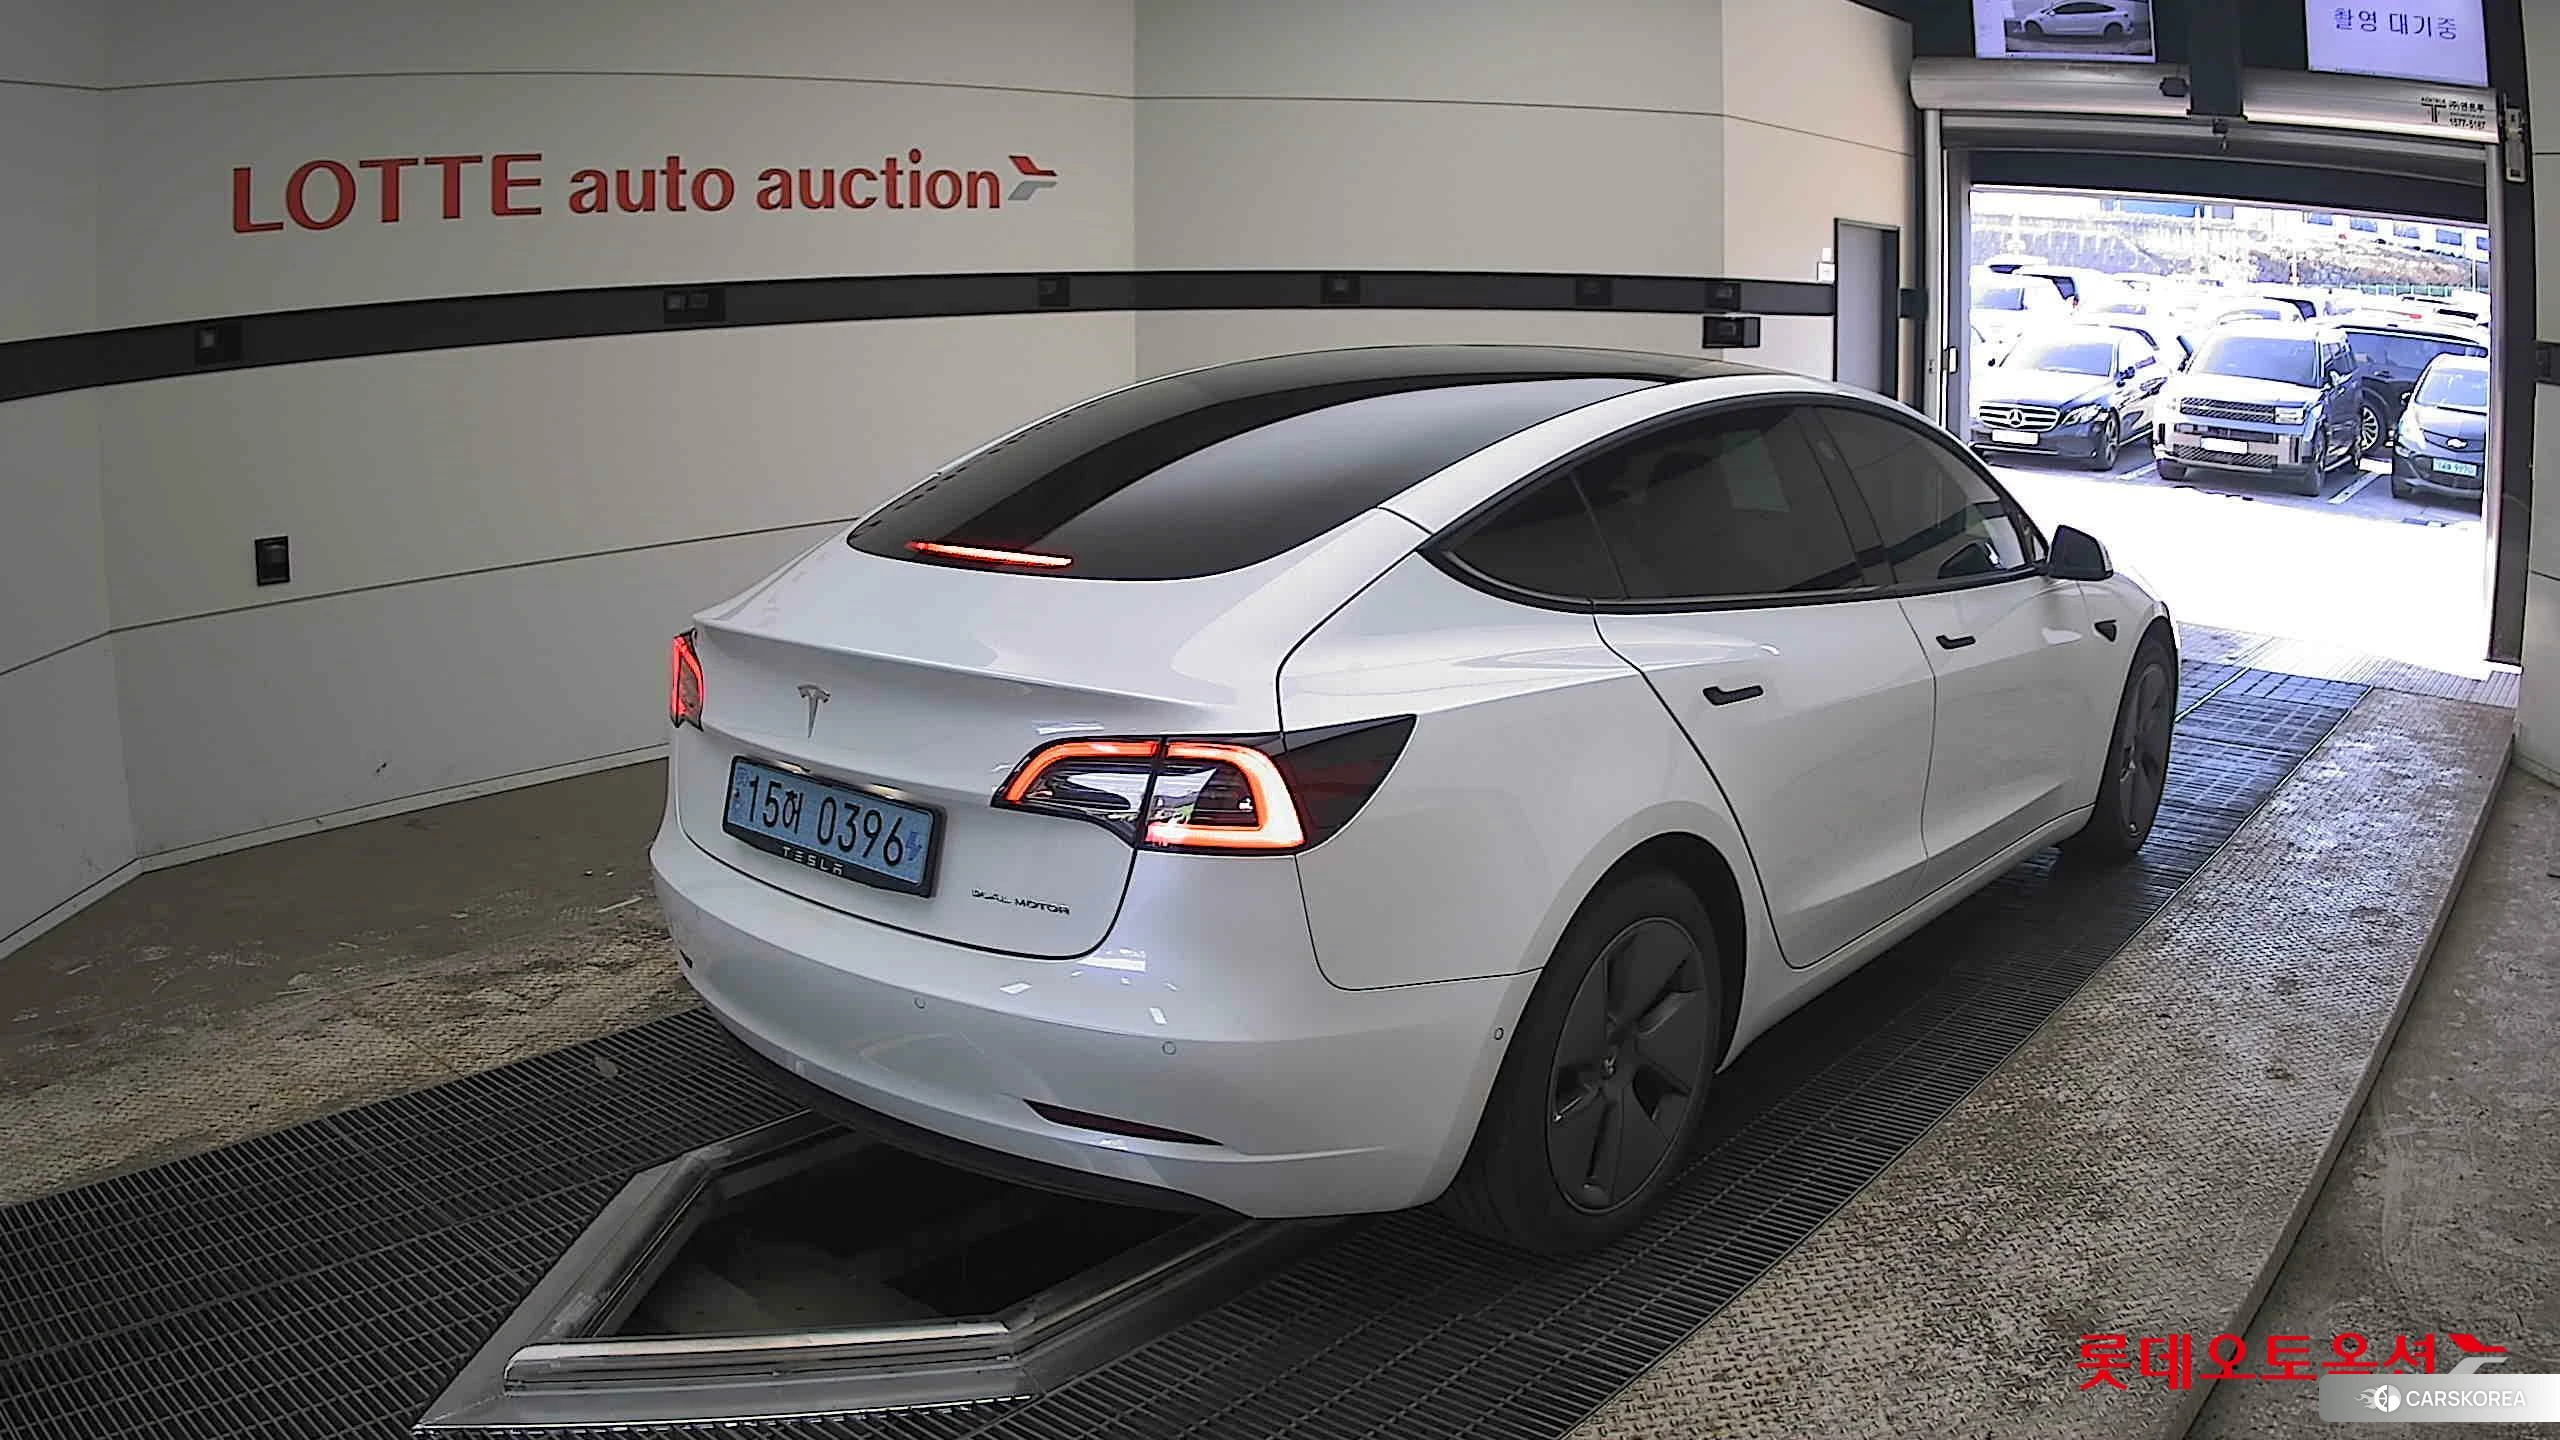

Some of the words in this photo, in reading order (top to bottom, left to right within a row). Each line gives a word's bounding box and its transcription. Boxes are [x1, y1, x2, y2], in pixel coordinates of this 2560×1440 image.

[2334, 8, 2377, 32] 촬영
[2389, 13, 2457, 40] 대기중
[232, 153, 542, 234] LOTTE
[568, 155, 735, 214] auto
[756, 147, 1000, 210] auction
[749, 775, 804, 835] 15허
[817, 796, 903, 866] 0396
[782, 846, 845, 876] TESLA
[1014, 897, 1071, 915] MOTOR
